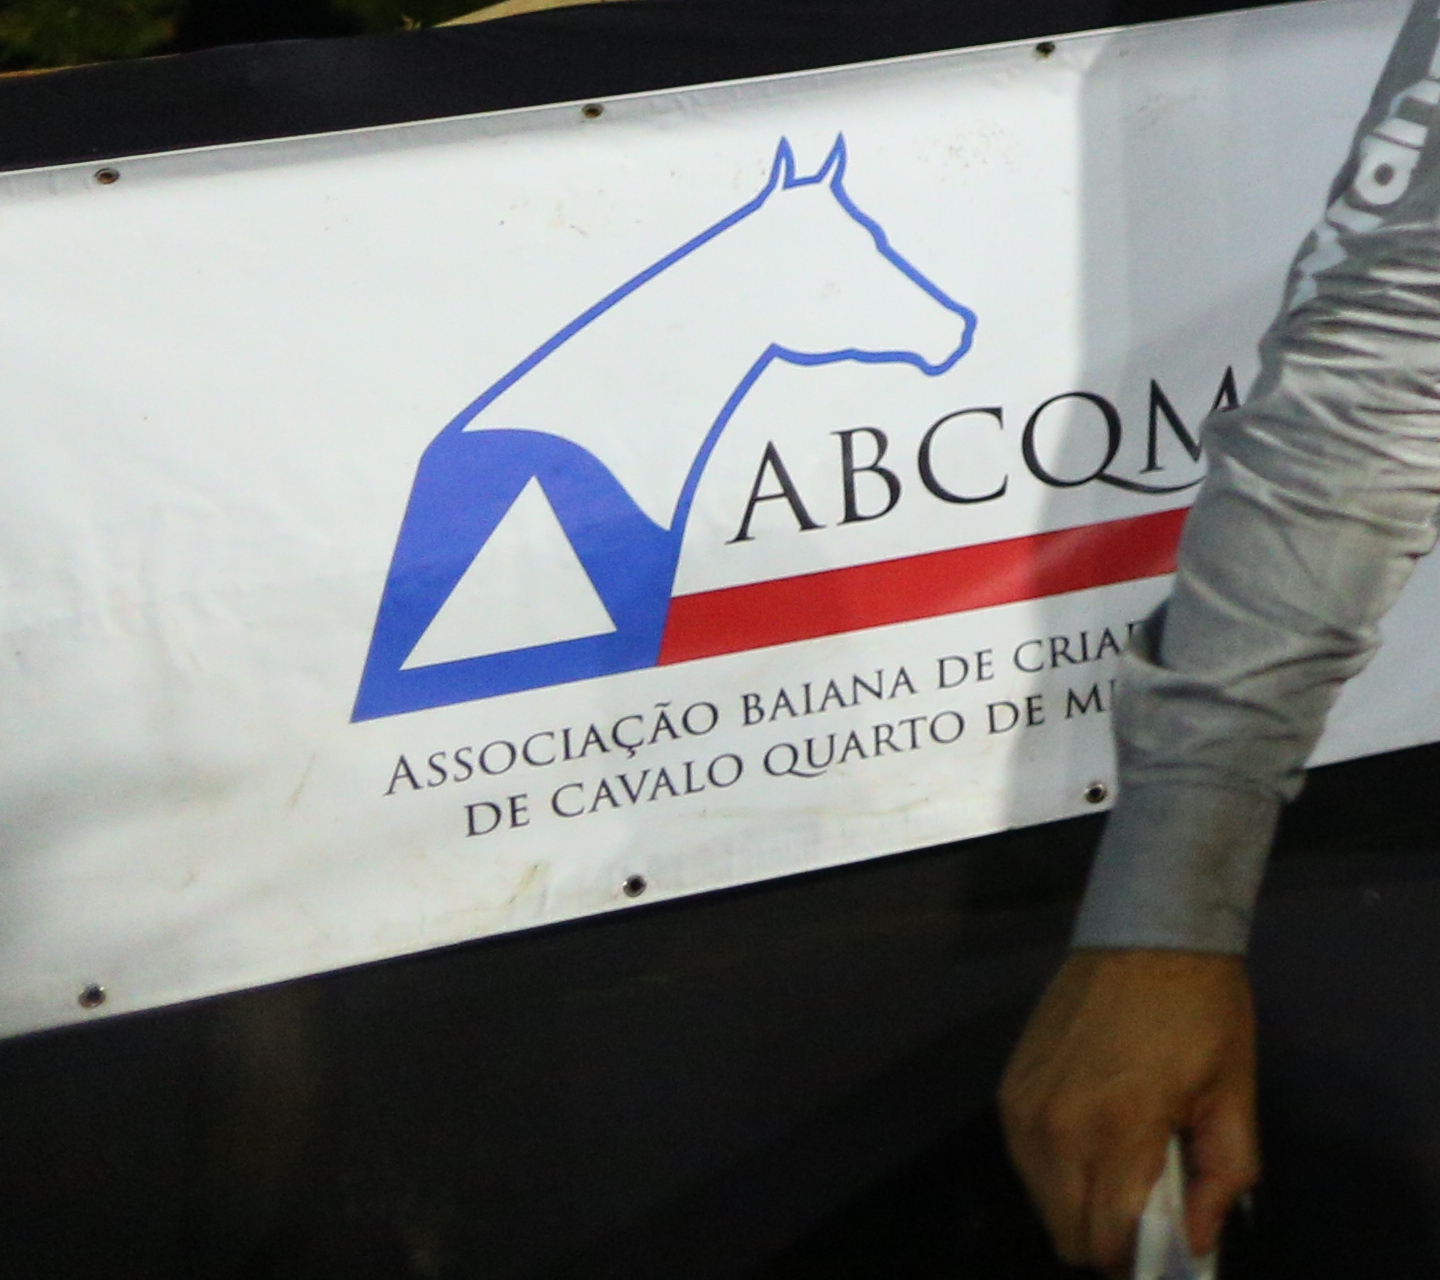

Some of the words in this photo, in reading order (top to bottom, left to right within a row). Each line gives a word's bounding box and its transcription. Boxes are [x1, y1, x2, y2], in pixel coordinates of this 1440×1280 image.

[726, 366, 1241, 545] ABCQM
[383, 699, 719, 797] ASSOCIAÇÃO
[741, 666, 911, 728] BAIANA
[937, 650, 995, 689] DE
[1012, 622, 1138, 675] CRIA
[464, 794, 531, 838] DE
[550, 753, 744, 819] CAVALO
[763, 710, 967, 779] QUARTO
[986, 695, 1044, 735] DE
